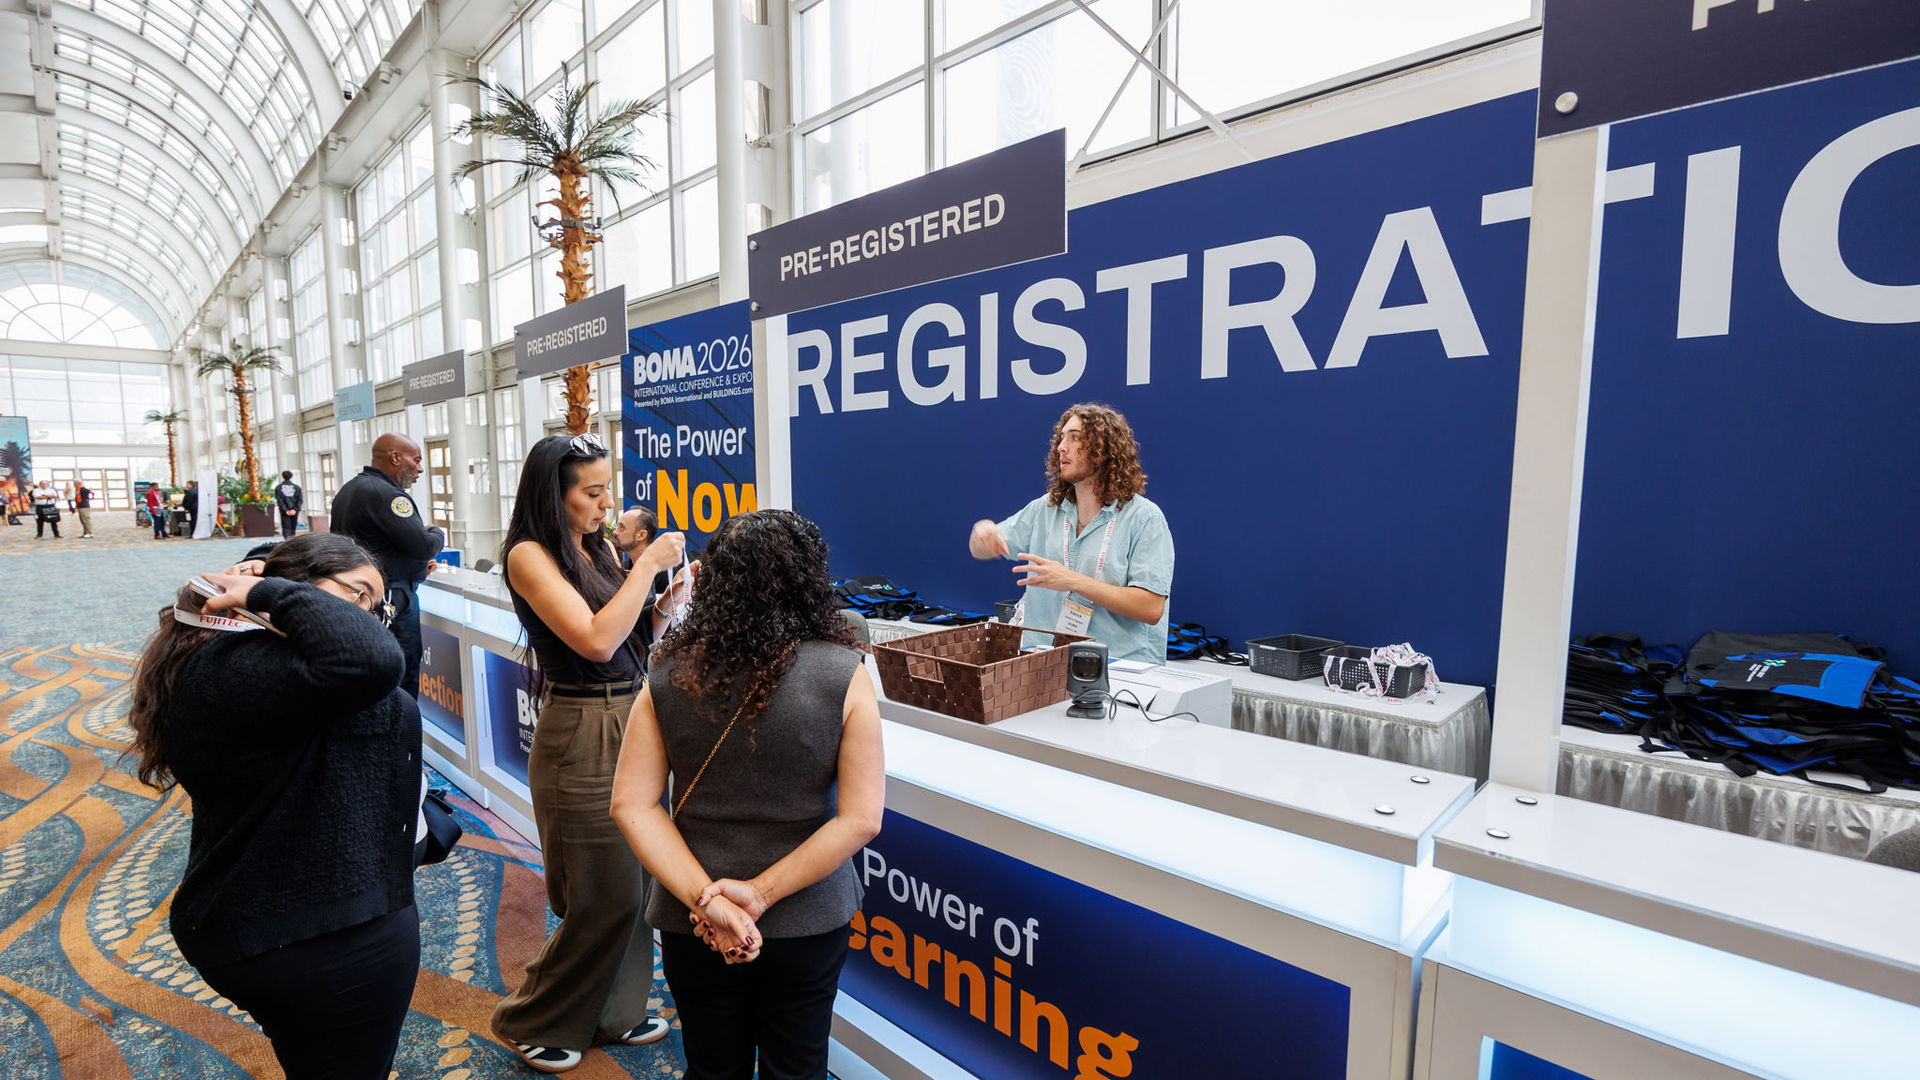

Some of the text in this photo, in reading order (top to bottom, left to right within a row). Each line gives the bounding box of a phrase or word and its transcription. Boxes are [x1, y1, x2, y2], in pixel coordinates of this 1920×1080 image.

[780, 193, 1006, 282] PRE-REGISTERED
[526, 316, 607, 357] PRE-REGISTERED
[633, 333, 752, 386] BOMA 2026
[409, 368, 456, 390] PRE-REGISTERED
[633, 370, 753, 398] INTERNATIONAL CONFERENCE & EXPO
[633, 386, 754, 408] Presented by BOMA International and BUILDINGS.com
[634, 425, 747, 459] The Power
[635, 472, 652, 501] of
[199, 614, 243, 628] FUJITEC
[863, 846, 1039, 967] Power of
